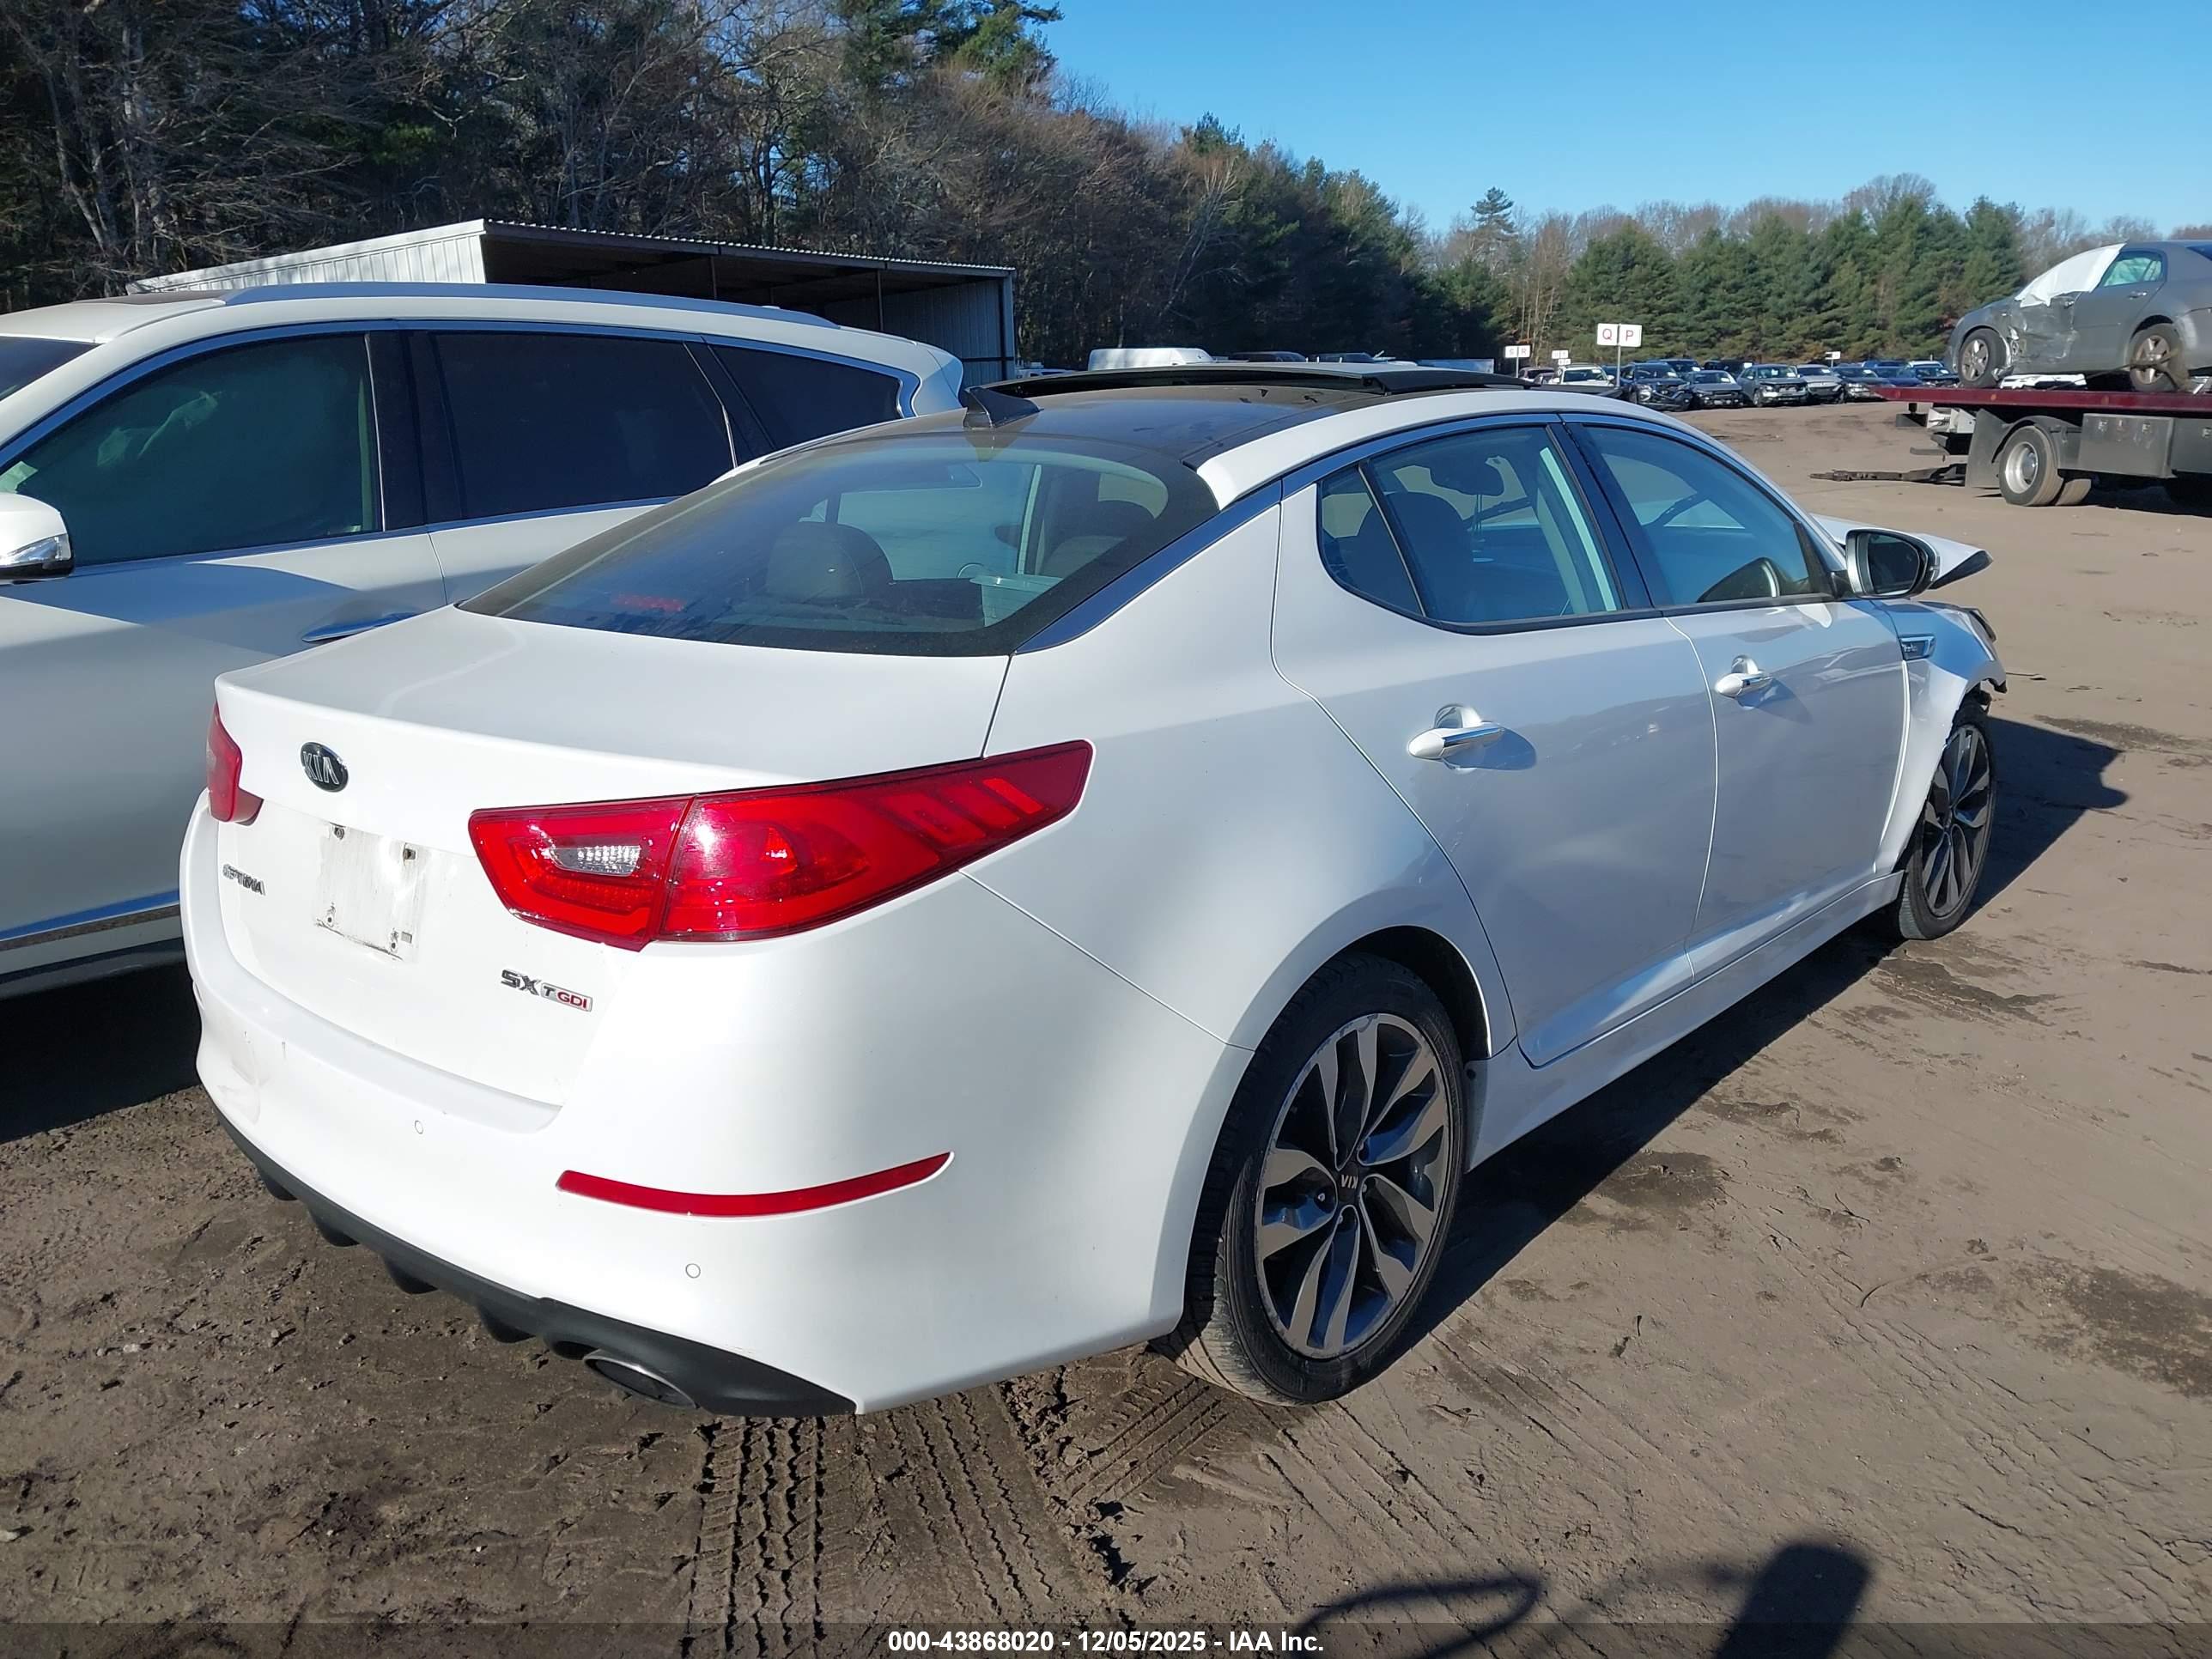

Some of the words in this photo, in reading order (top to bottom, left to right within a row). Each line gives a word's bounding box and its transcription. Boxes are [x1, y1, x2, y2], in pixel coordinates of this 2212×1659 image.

[1602, 328, 1613, 341] Q
[1626, 329, 1634, 342] P
[302, 750, 340, 785] KIA
[501, 969, 541, 996] SX
[1340, 1174, 1358, 1189] KIA
